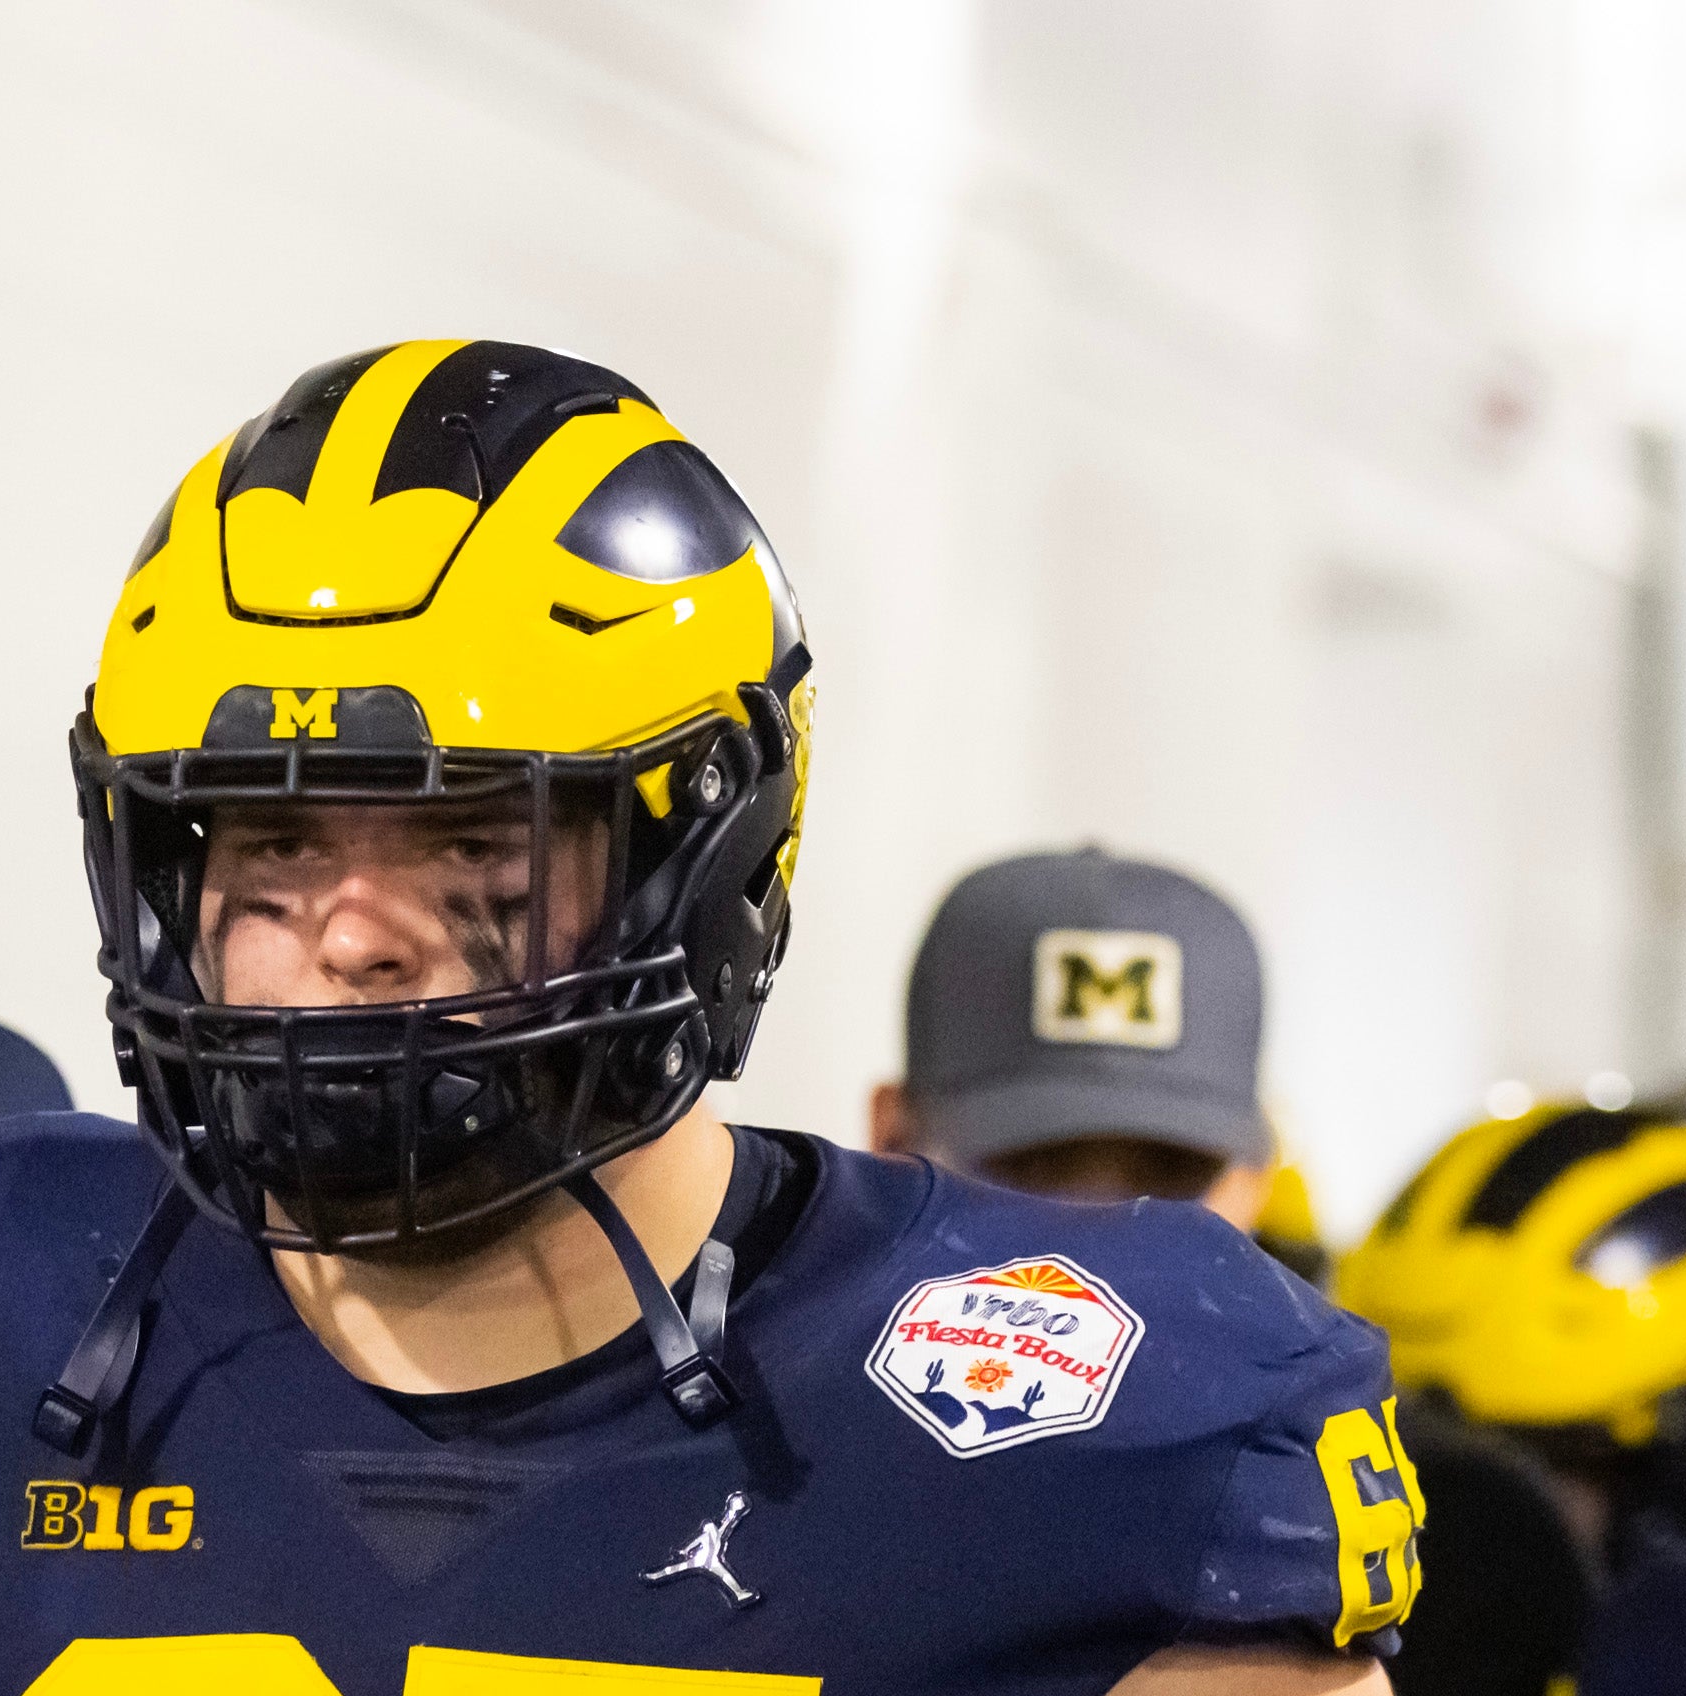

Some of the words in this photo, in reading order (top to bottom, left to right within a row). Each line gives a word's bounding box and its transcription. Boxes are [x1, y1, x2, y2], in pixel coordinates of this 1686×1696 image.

[269, 688, 338, 739] M
[1058, 953, 1154, 1024] M
[898, 1320, 1008, 1350] Fiesta
[1012, 1333, 1108, 1386] Bowl
